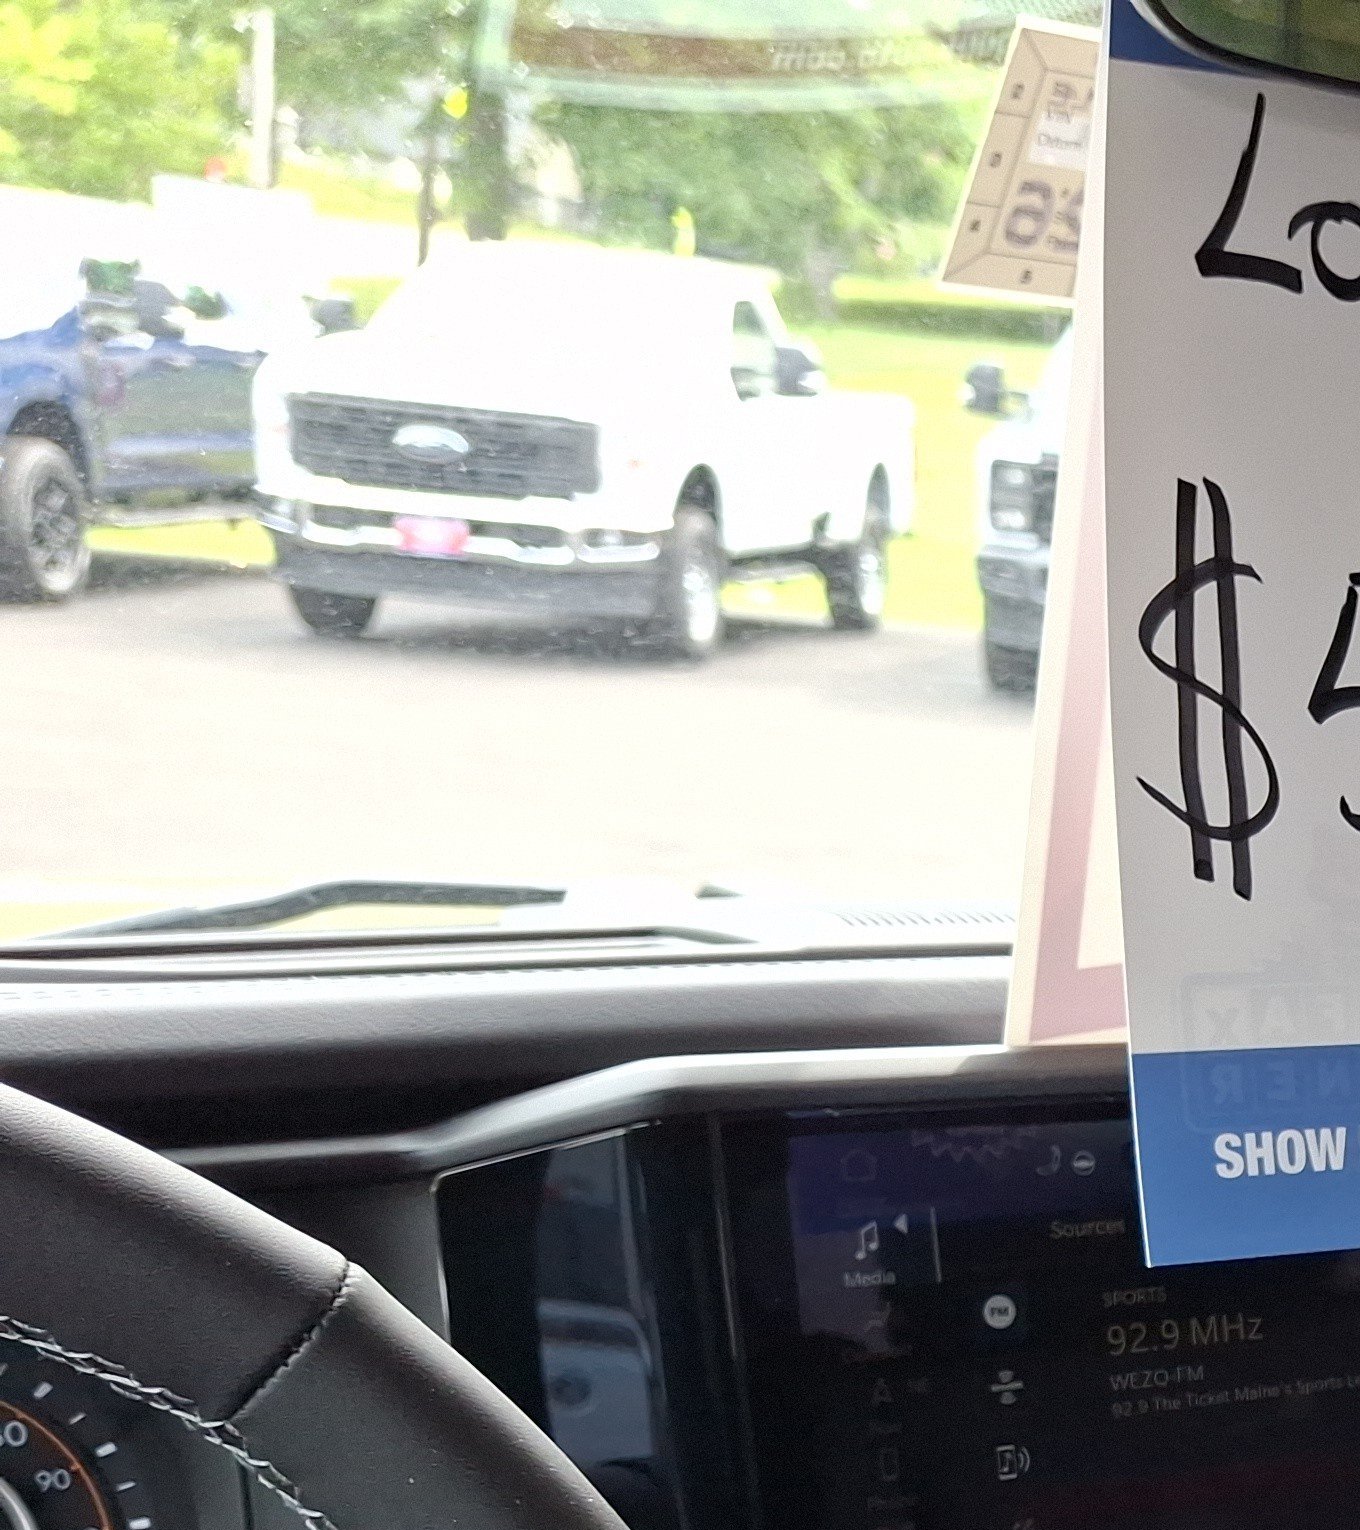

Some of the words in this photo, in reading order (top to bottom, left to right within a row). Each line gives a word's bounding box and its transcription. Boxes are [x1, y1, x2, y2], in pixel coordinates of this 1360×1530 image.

[1214, 1124, 1346, 1180] SHOW
[1050, 1218, 1125, 1240] Sources
[844, 1269, 896, 1288] Media
[1103, 1286, 1168, 1307] SPORTS
[1106, 1319, 1180, 1357] 92.9
[1189, 1313, 1263, 1347] MHz
[1187, 1389, 1230, 1408] Ticket
[35, 1468, 71, 1492] 90
